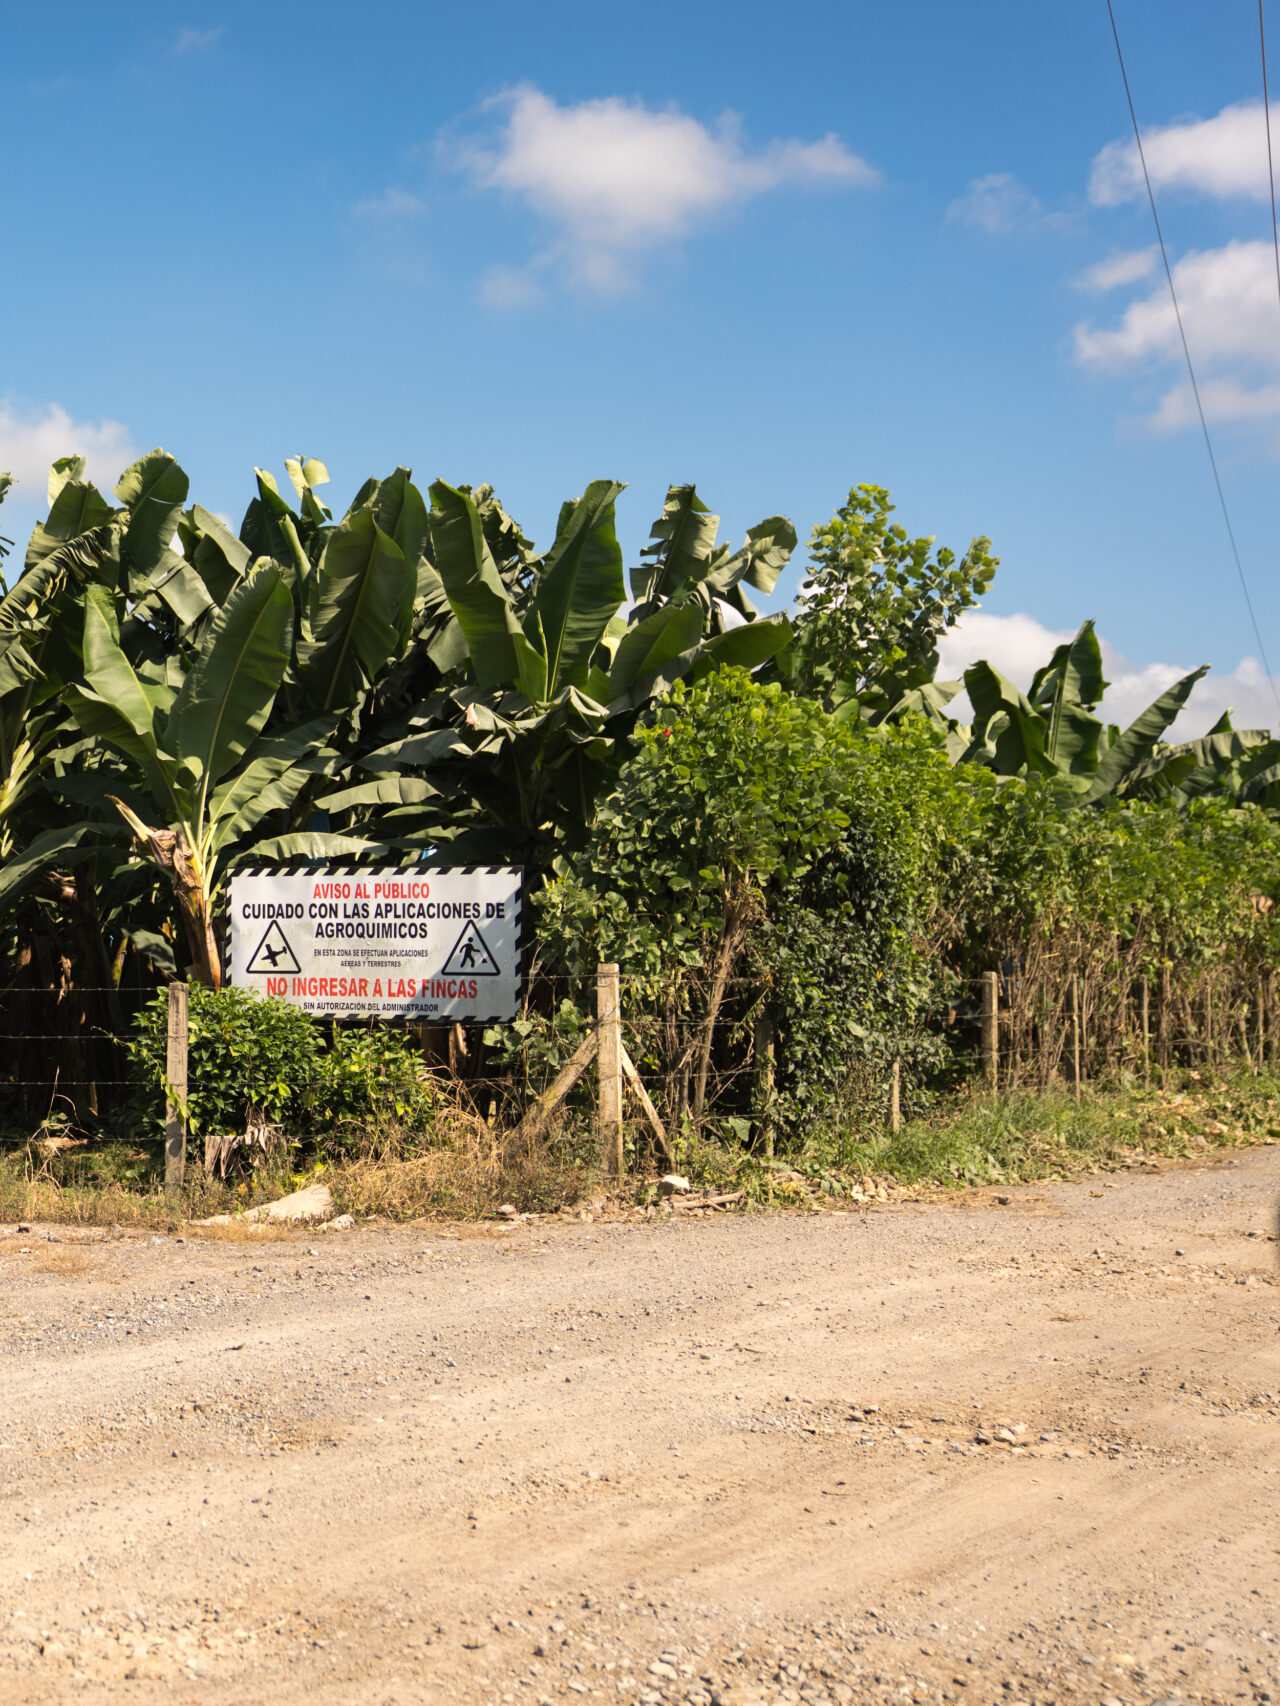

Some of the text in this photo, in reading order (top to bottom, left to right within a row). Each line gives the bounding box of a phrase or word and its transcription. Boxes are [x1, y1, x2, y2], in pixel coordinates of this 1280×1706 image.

[313, 880, 430, 899] AVISO AL PÚBLICO
[242, 903, 505, 919] CUIDADO CON LAS APLICACIONES DE
[315, 922, 428, 939] AGROQUIMICOS
[361, 949, 387, 957] EFECTUAN
[266, 978, 478, 999] NO INGRESAR A LAS FINCAS
[303, 1002, 314, 1010] SIN
[367, 1003, 380, 1011] DEL
[382, 1003, 438, 1012] ADMINISTRADOR
